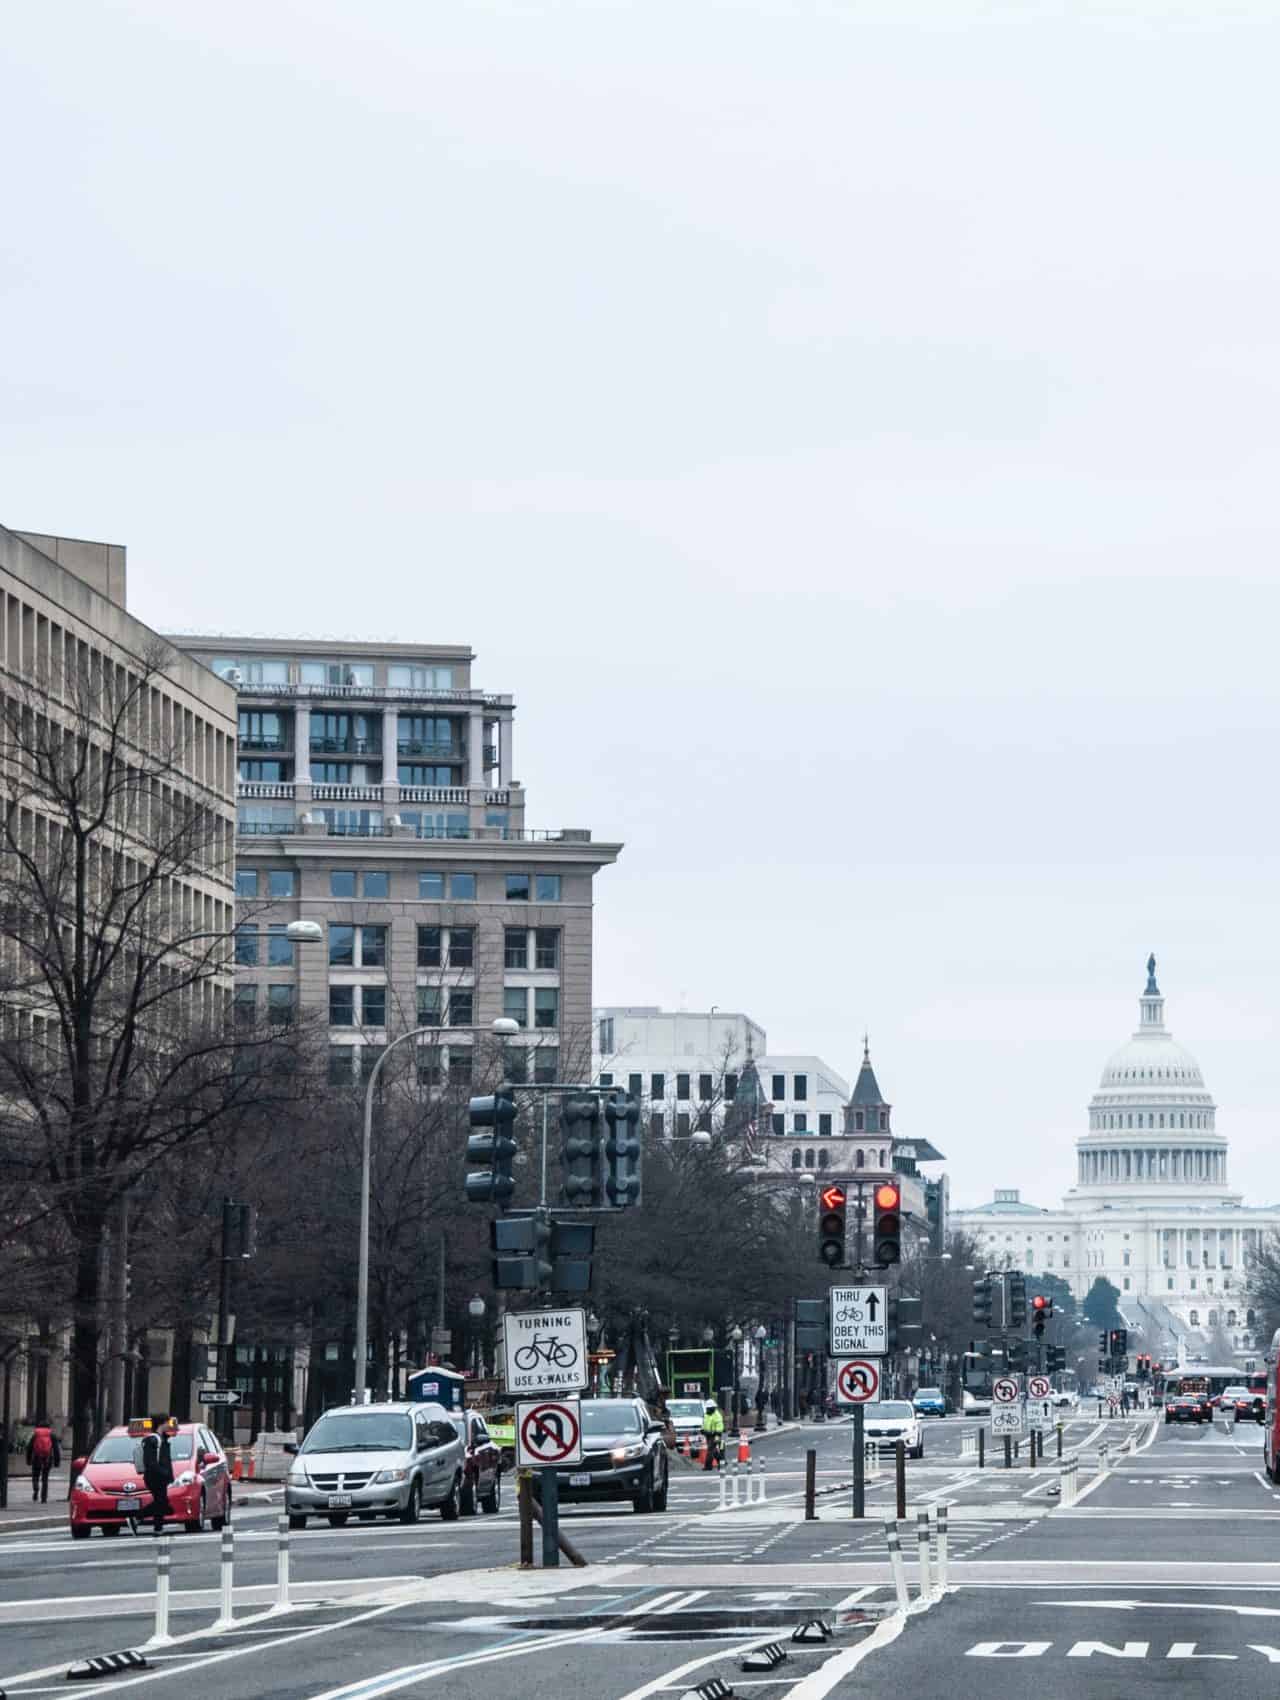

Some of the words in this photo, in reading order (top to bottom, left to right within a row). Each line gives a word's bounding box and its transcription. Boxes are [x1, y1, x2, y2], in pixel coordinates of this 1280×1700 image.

[835, 1291, 860, 1302] THRU
[518, 1316, 572, 1329] TURNING
[834, 1326, 859, 1337] OBEY
[863, 1325, 884, 1337] THIS
[834, 1339, 869, 1350] SIGNAL
[514, 1376, 534, 1387] USE
[536, 1373, 581, 1385] X-WALKS
